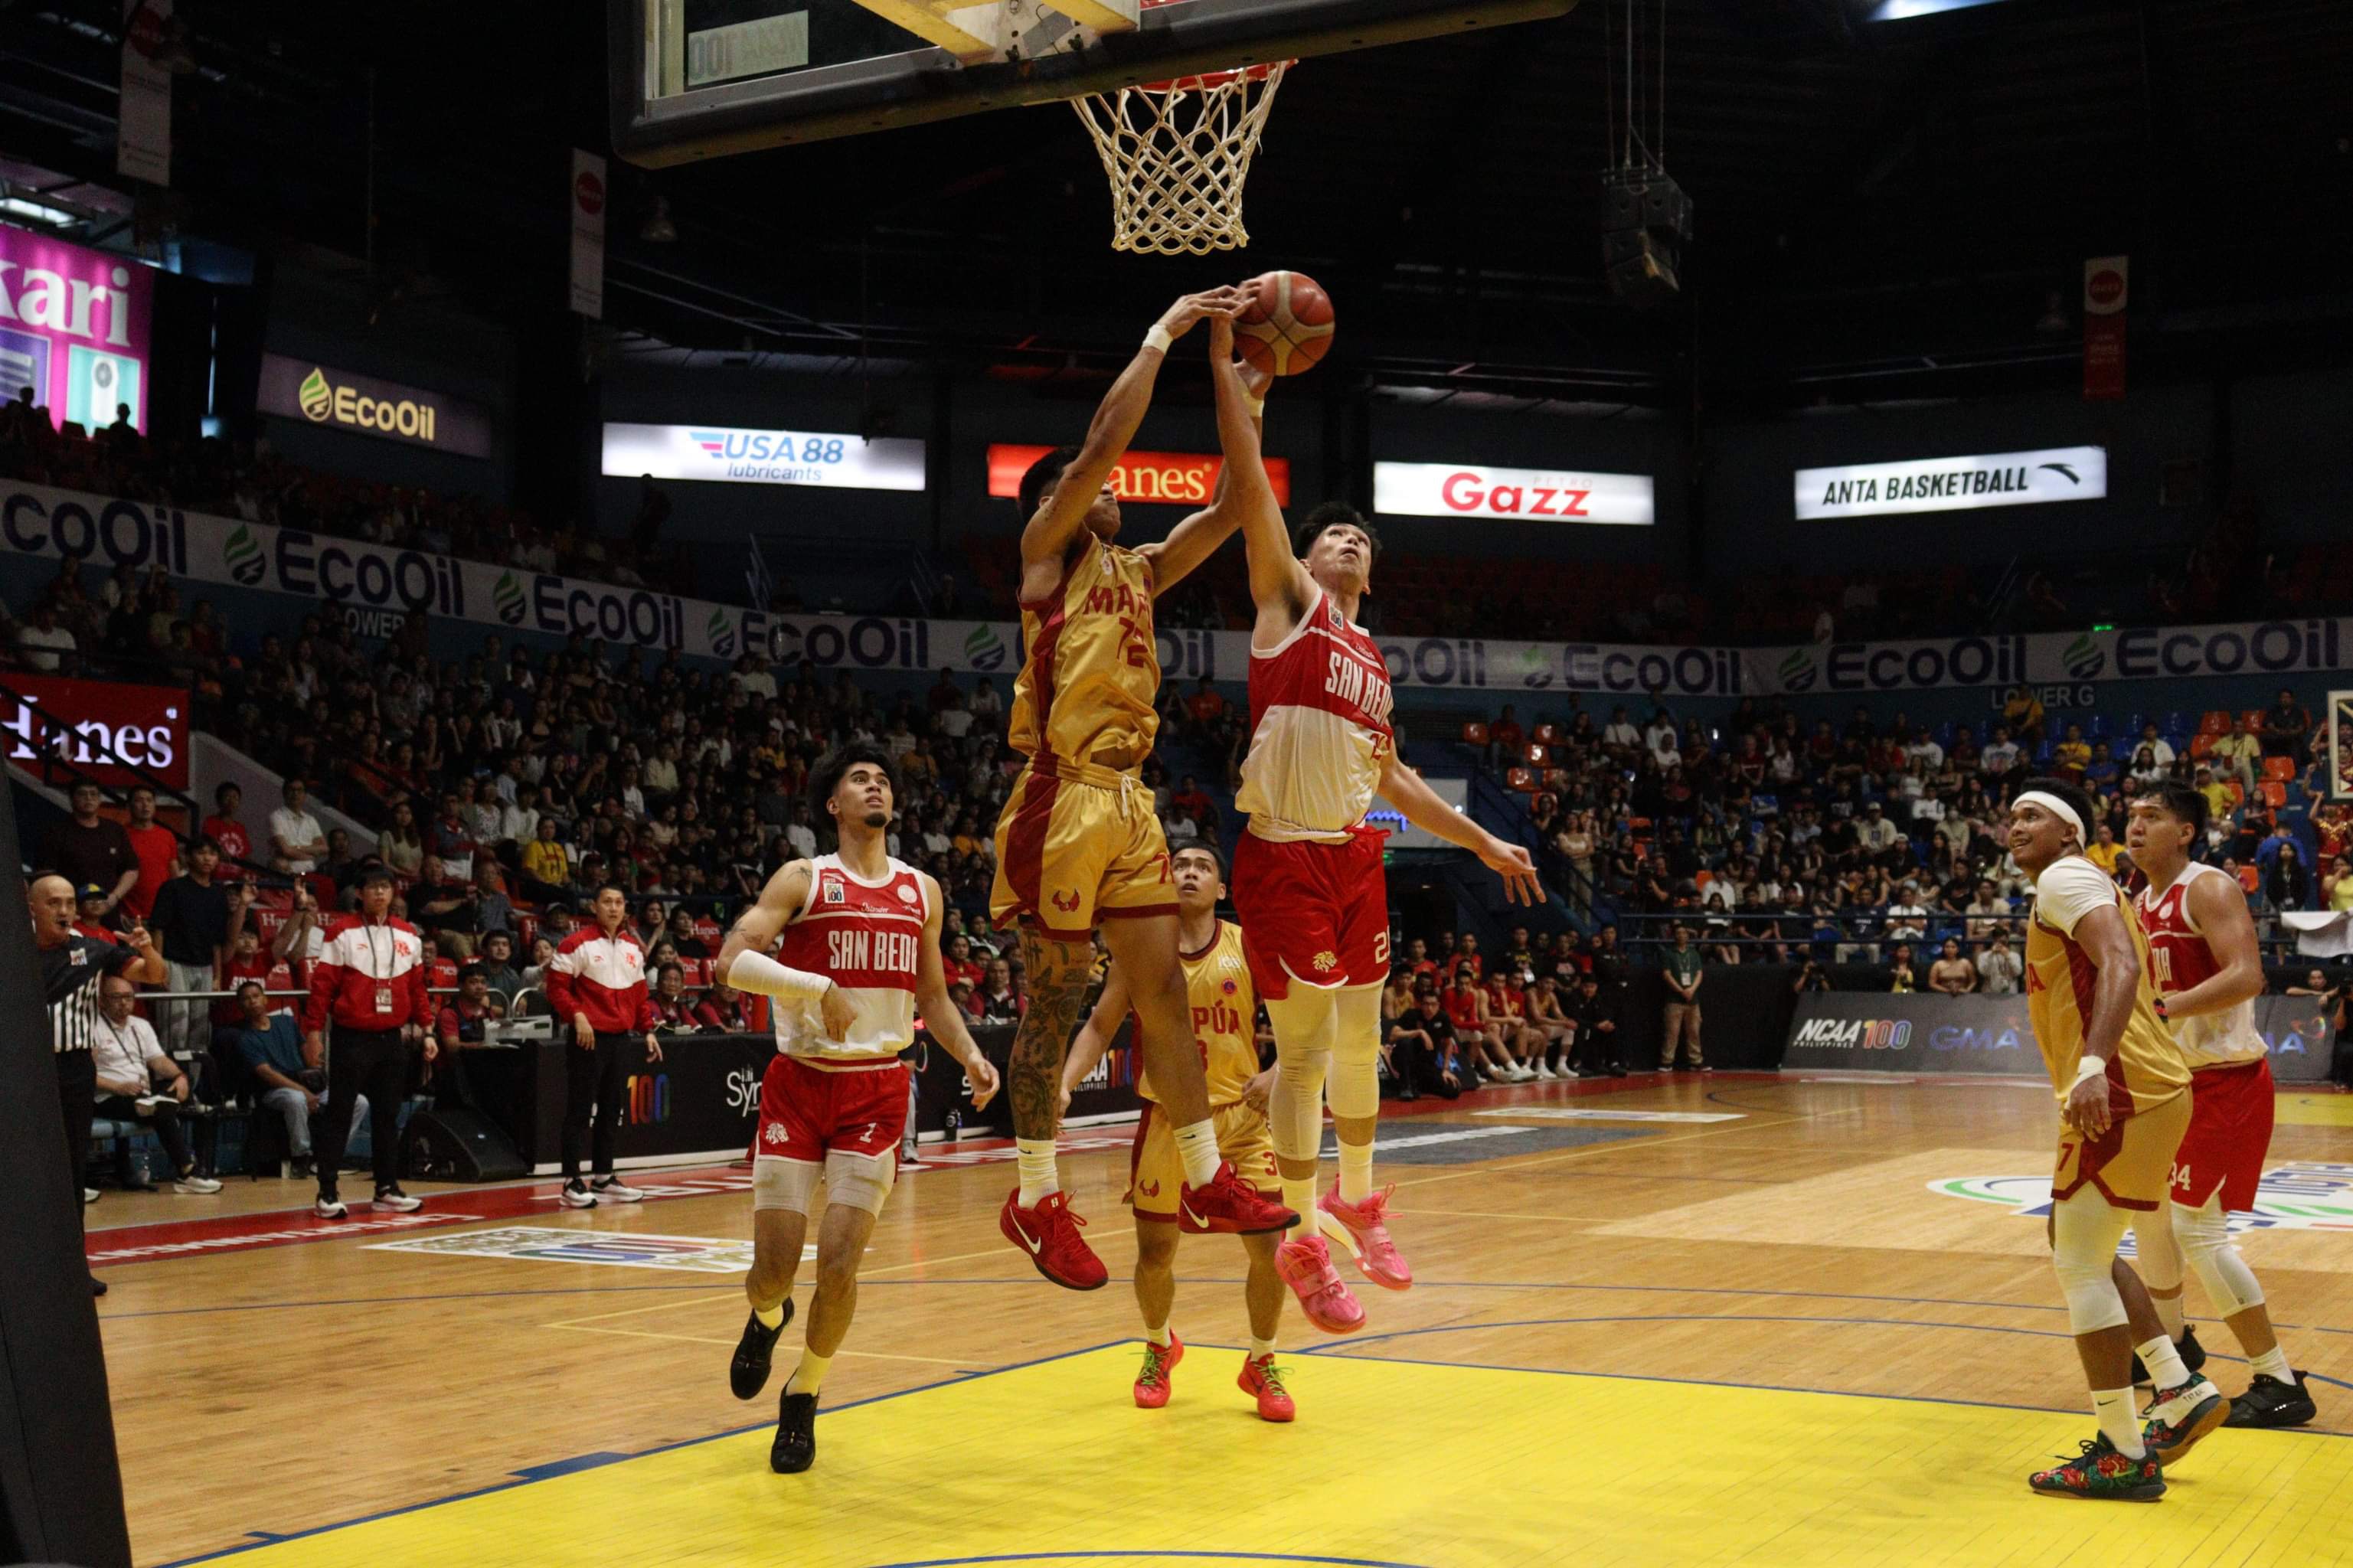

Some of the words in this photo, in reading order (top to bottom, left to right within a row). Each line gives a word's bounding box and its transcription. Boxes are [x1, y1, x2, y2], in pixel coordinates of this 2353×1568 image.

[335, 385, 435, 442] EcoOil
[724, 433, 796, 462] USA
[802, 438, 845, 464] 88
[727, 462, 822, 482] lubricants
[1108, 465, 1206, 500] anes
[1533, 476, 1593, 488] PETRO
[1822, 480, 1877, 506] ANTA
[1885, 466, 2029, 501] BASKETBALL
[1442, 472, 1591, 517] Gazz
[3, 494, 186, 574] coOil
[276, 526, 465, 616] EcoOil
[534, 575, 685, 650] EcoOil
[741, 612, 929, 668] EcoOil
[1828, 629, 2028, 690] EcoOil
[2116, 619, 2339, 677] EcoOil
[1325, 651, 1364, 706] SAN
[1381, 637, 1486, 687] oOil
[1564, 645, 1742, 694] EcoOil
[2077, 685, 2096, 706] G
[828, 930, 869, 970] SAN
[1374, 925, 1391, 964] 2
[1191, 999, 1240, 1035] PÚA
[1798, 1019, 1863, 1043] NCAA
[1862, 1019, 1913, 1050] 100
[1793, 1040, 1854, 1049] PHILIPPINES
[1930, 1026, 2021, 1051] GMA
[626, 1073, 670, 1126] 100
[858, 1122, 876, 1144] 1
[1263, 1152, 1279, 1177] 3
[2057, 1142, 2074, 1171] 7
